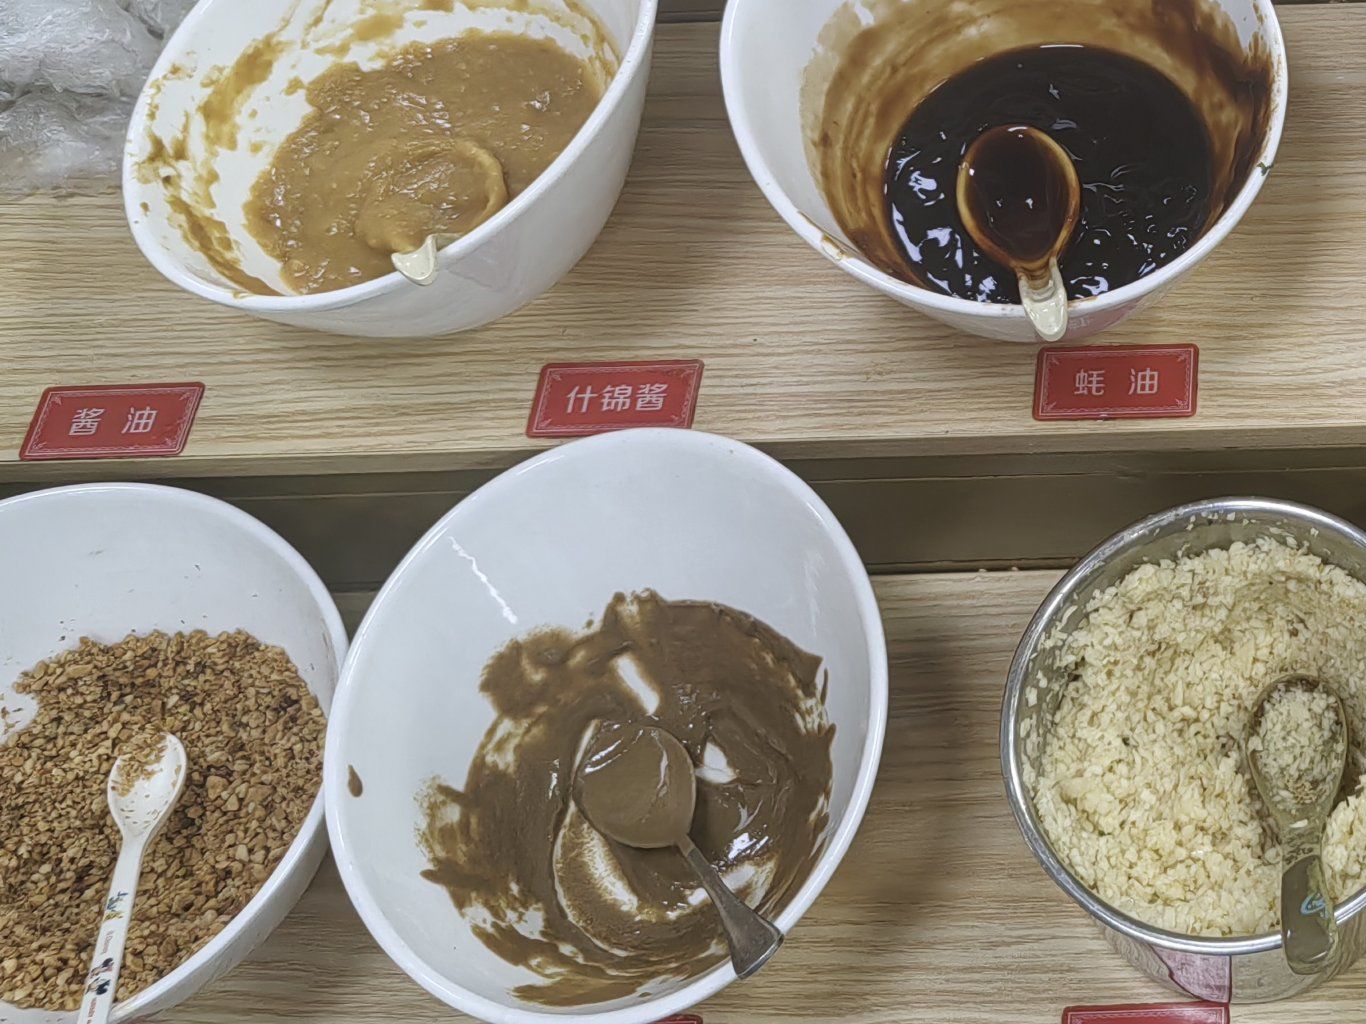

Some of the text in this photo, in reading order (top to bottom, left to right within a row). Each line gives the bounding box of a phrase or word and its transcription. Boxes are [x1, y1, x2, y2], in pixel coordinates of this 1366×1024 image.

[1073, 367, 1160, 396] 蚝油
[565, 382, 669, 414] 什锦酱
[67, 406, 160, 437] 酱油
